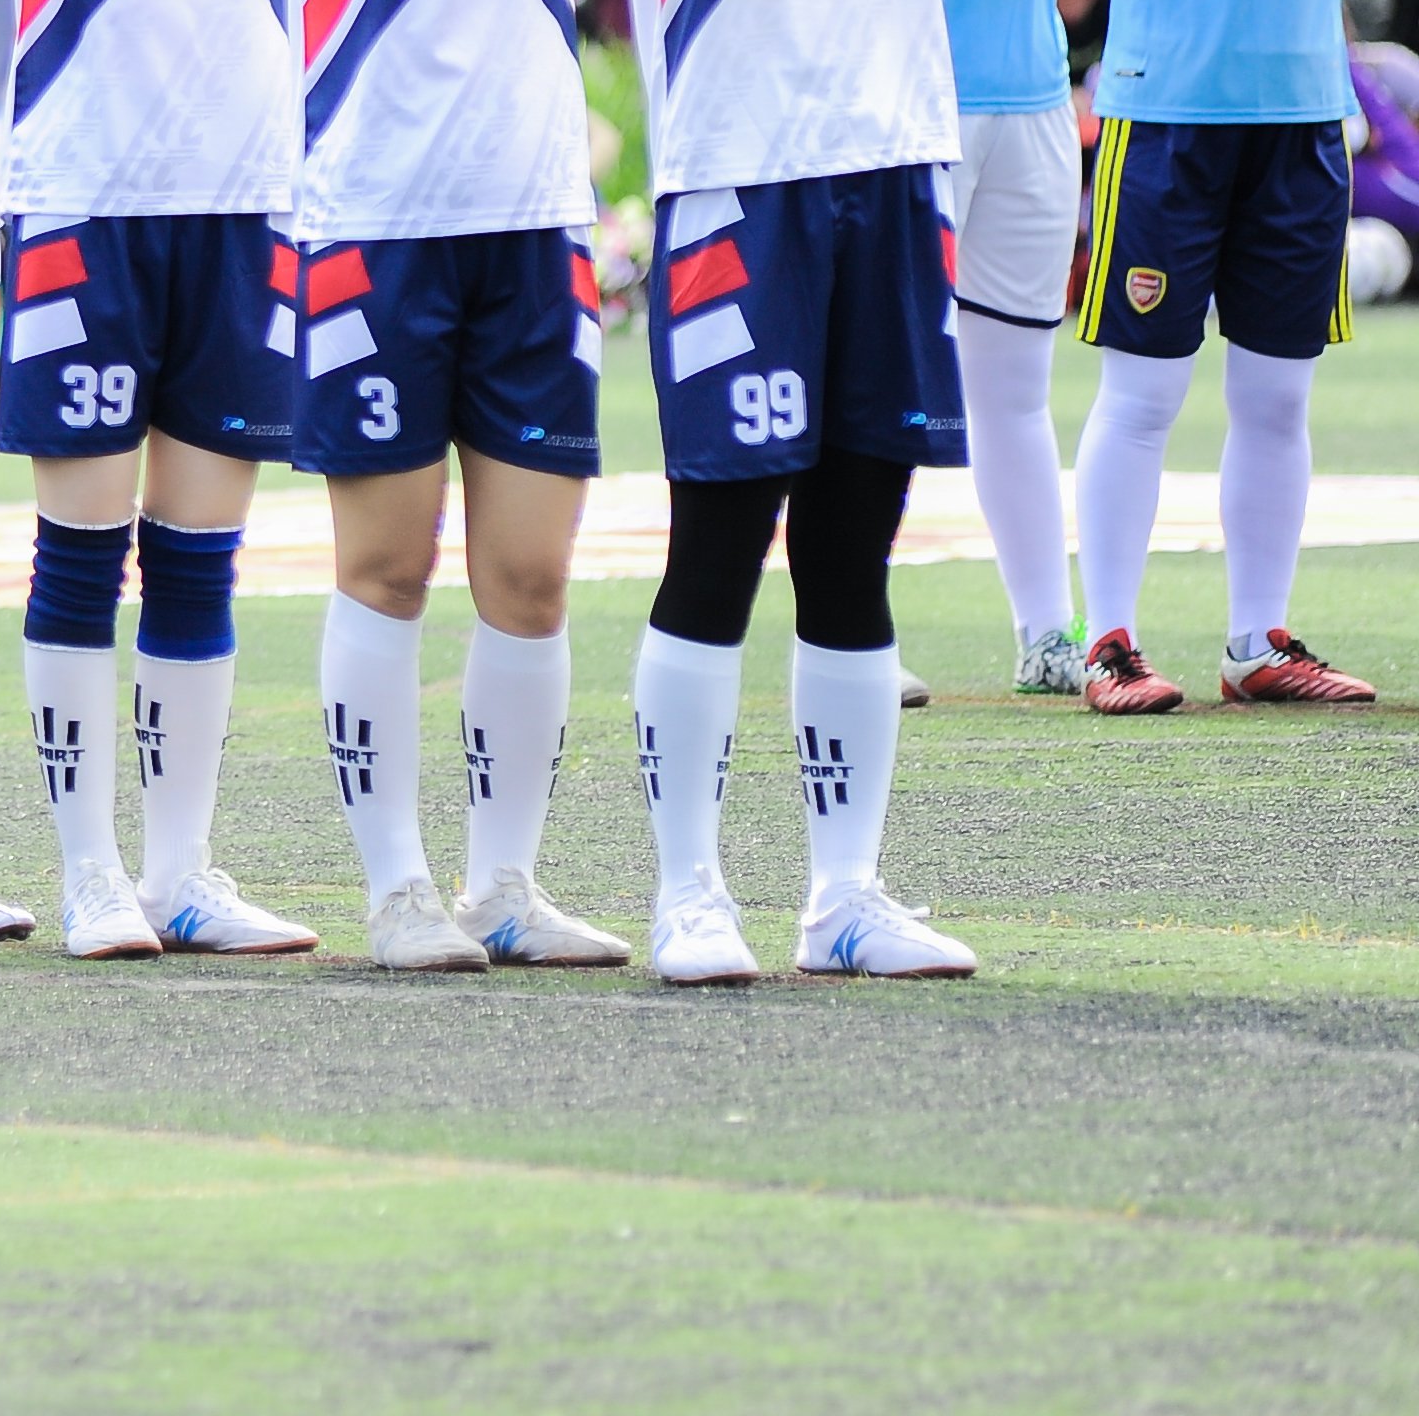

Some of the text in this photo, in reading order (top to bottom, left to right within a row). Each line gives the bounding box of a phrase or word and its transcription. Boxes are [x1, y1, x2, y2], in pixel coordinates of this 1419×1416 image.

[62, 365, 138, 430] 39
[360, 376, 400, 442] 3
[731, 369, 808, 446] 99
[36, 745, 85, 763] PORT
[329, 743, 379, 765] PORT
[800, 764, 854, 779] PORT
